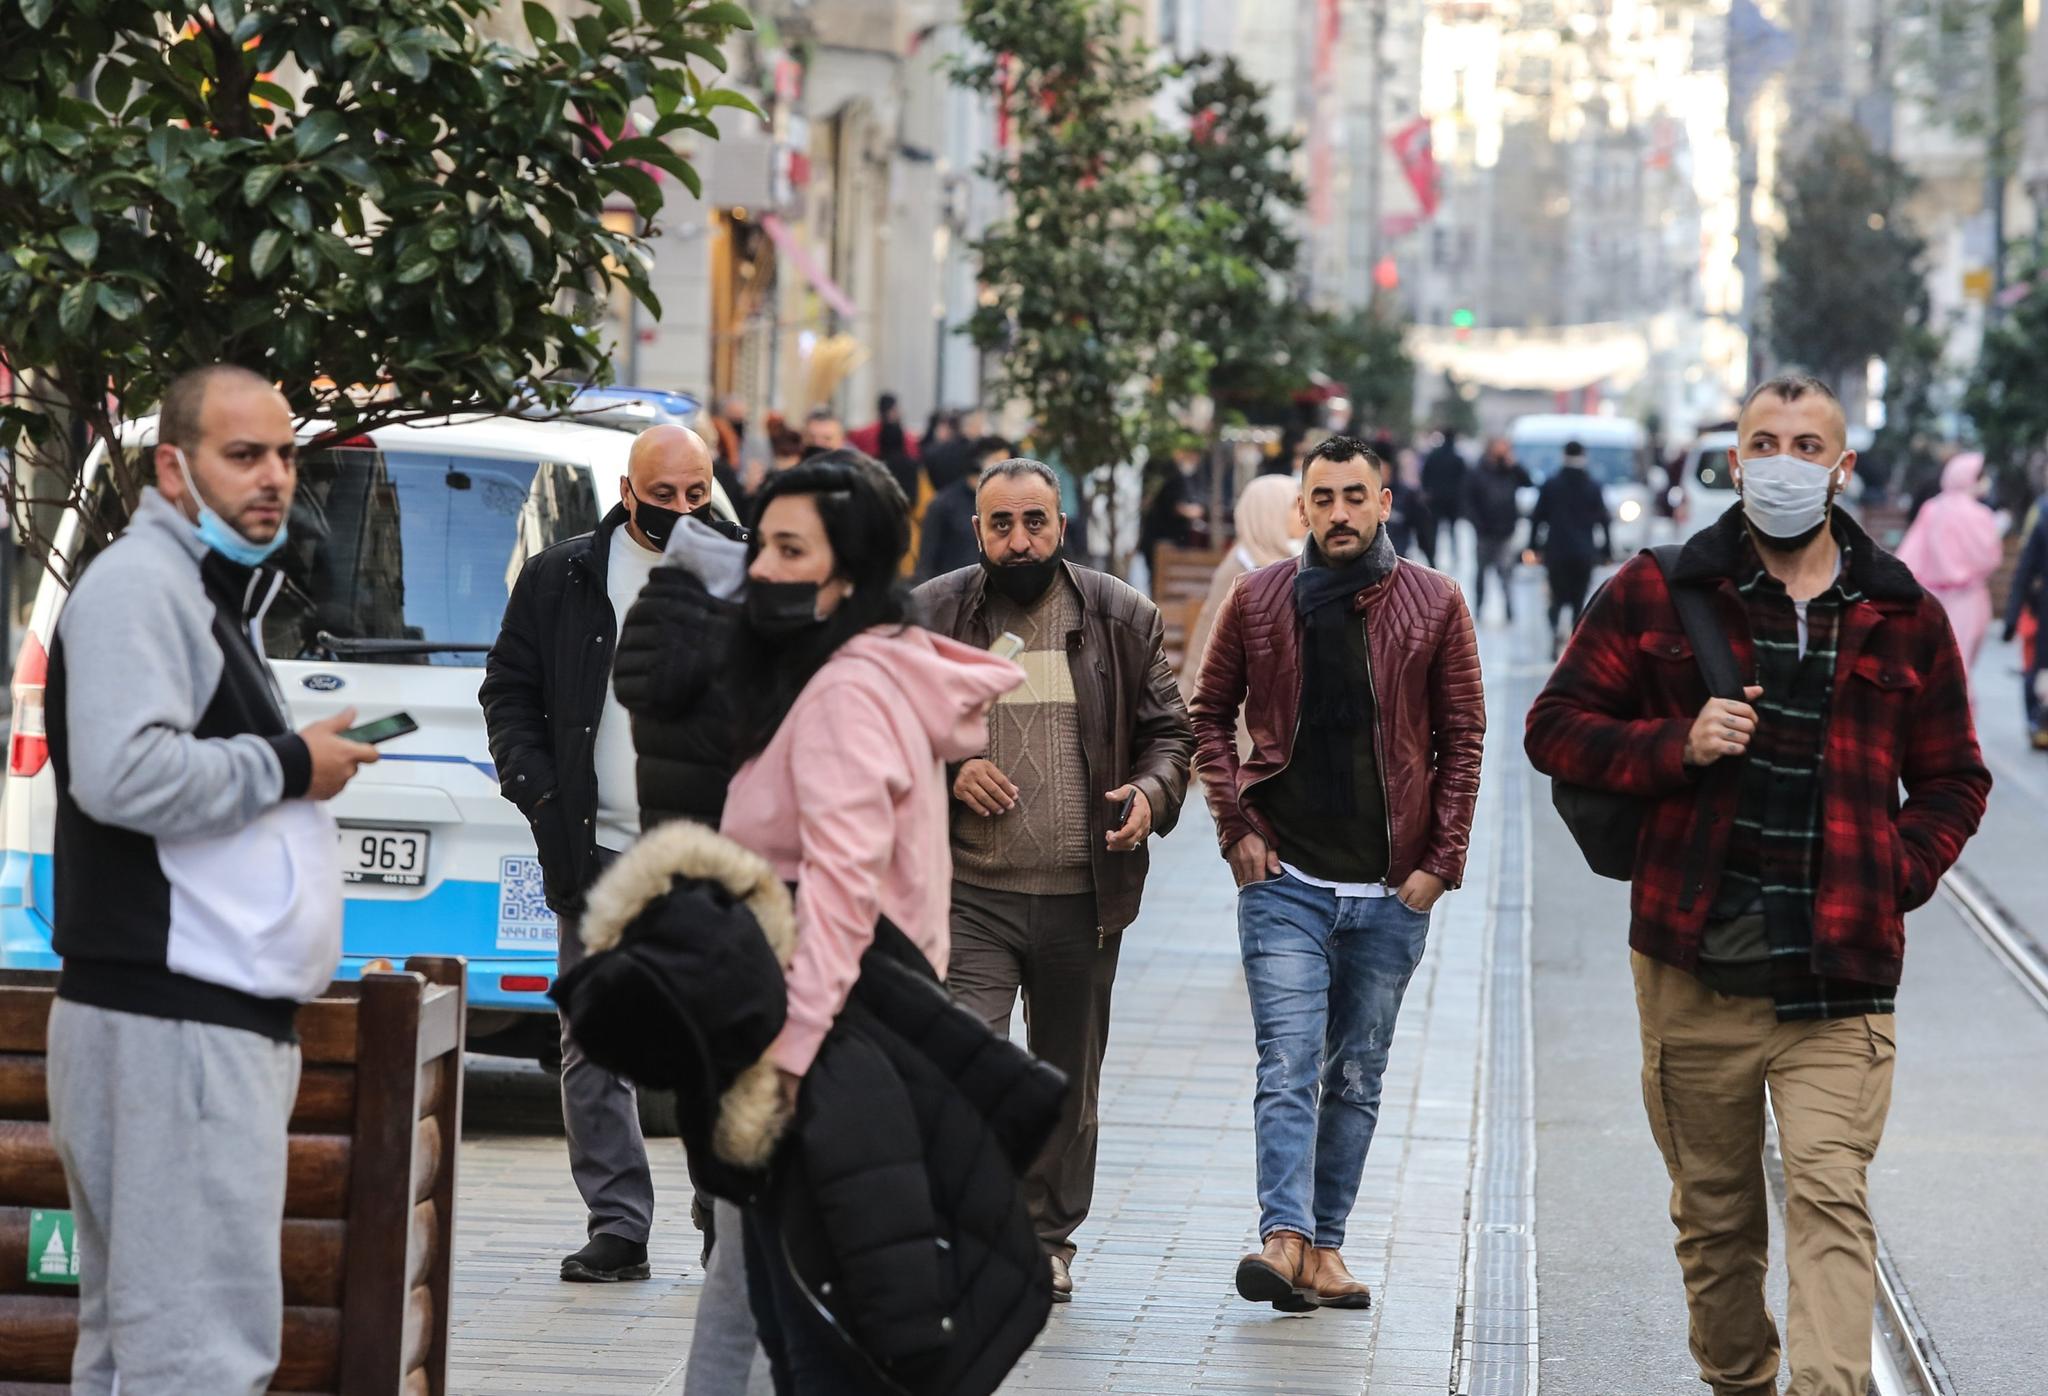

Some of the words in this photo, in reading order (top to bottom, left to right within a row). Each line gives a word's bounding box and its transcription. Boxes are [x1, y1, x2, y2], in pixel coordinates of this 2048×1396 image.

[308, 677, 338, 690] Ford
[360, 836, 416, 871] 963
[501, 926, 526, 937] 444
